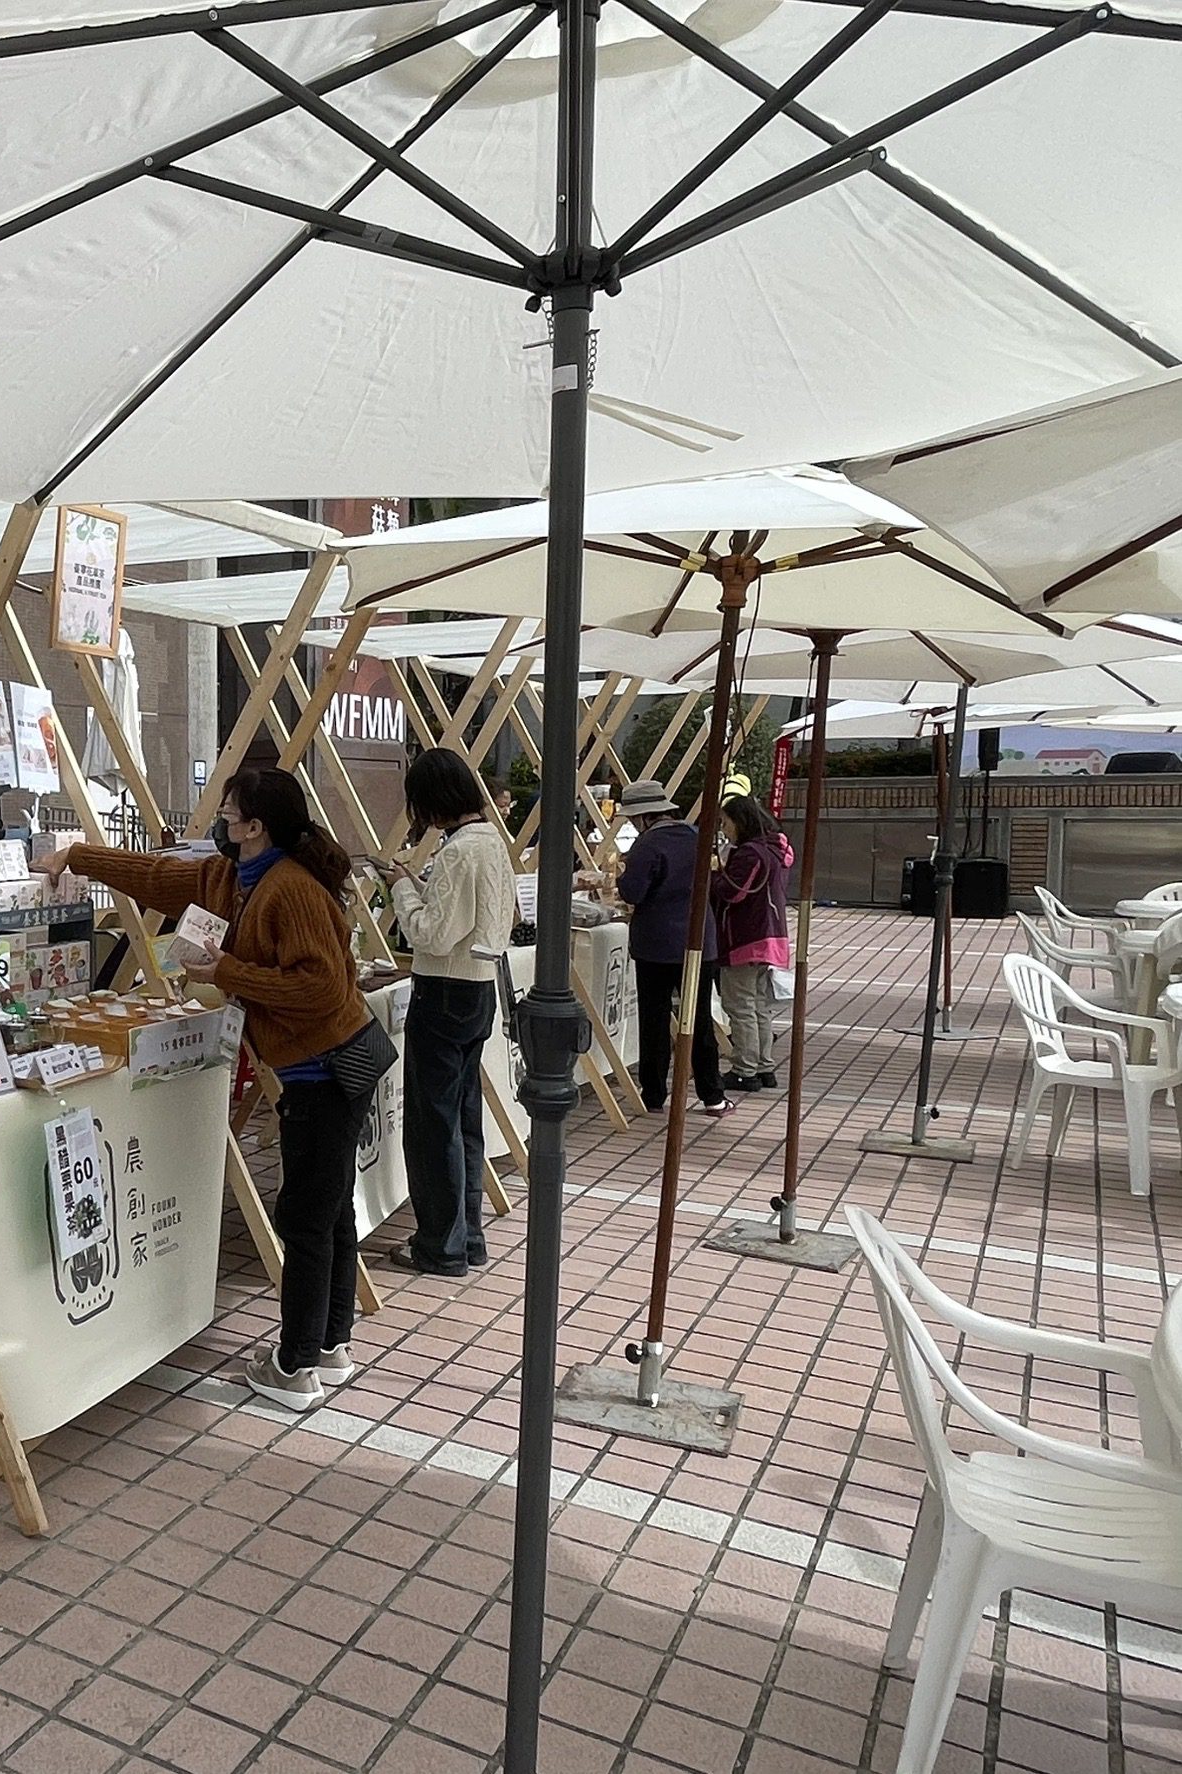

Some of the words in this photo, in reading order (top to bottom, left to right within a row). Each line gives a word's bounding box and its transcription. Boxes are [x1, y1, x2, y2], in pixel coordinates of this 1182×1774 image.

[323, 692, 403, 743] WFMM
[73, 1156, 93, 1184] 60
[124, 1136, 148, 1268] 農創家
[151, 1196, 176, 1215] FOUND
[152, 1211, 182, 1233] WONDER
